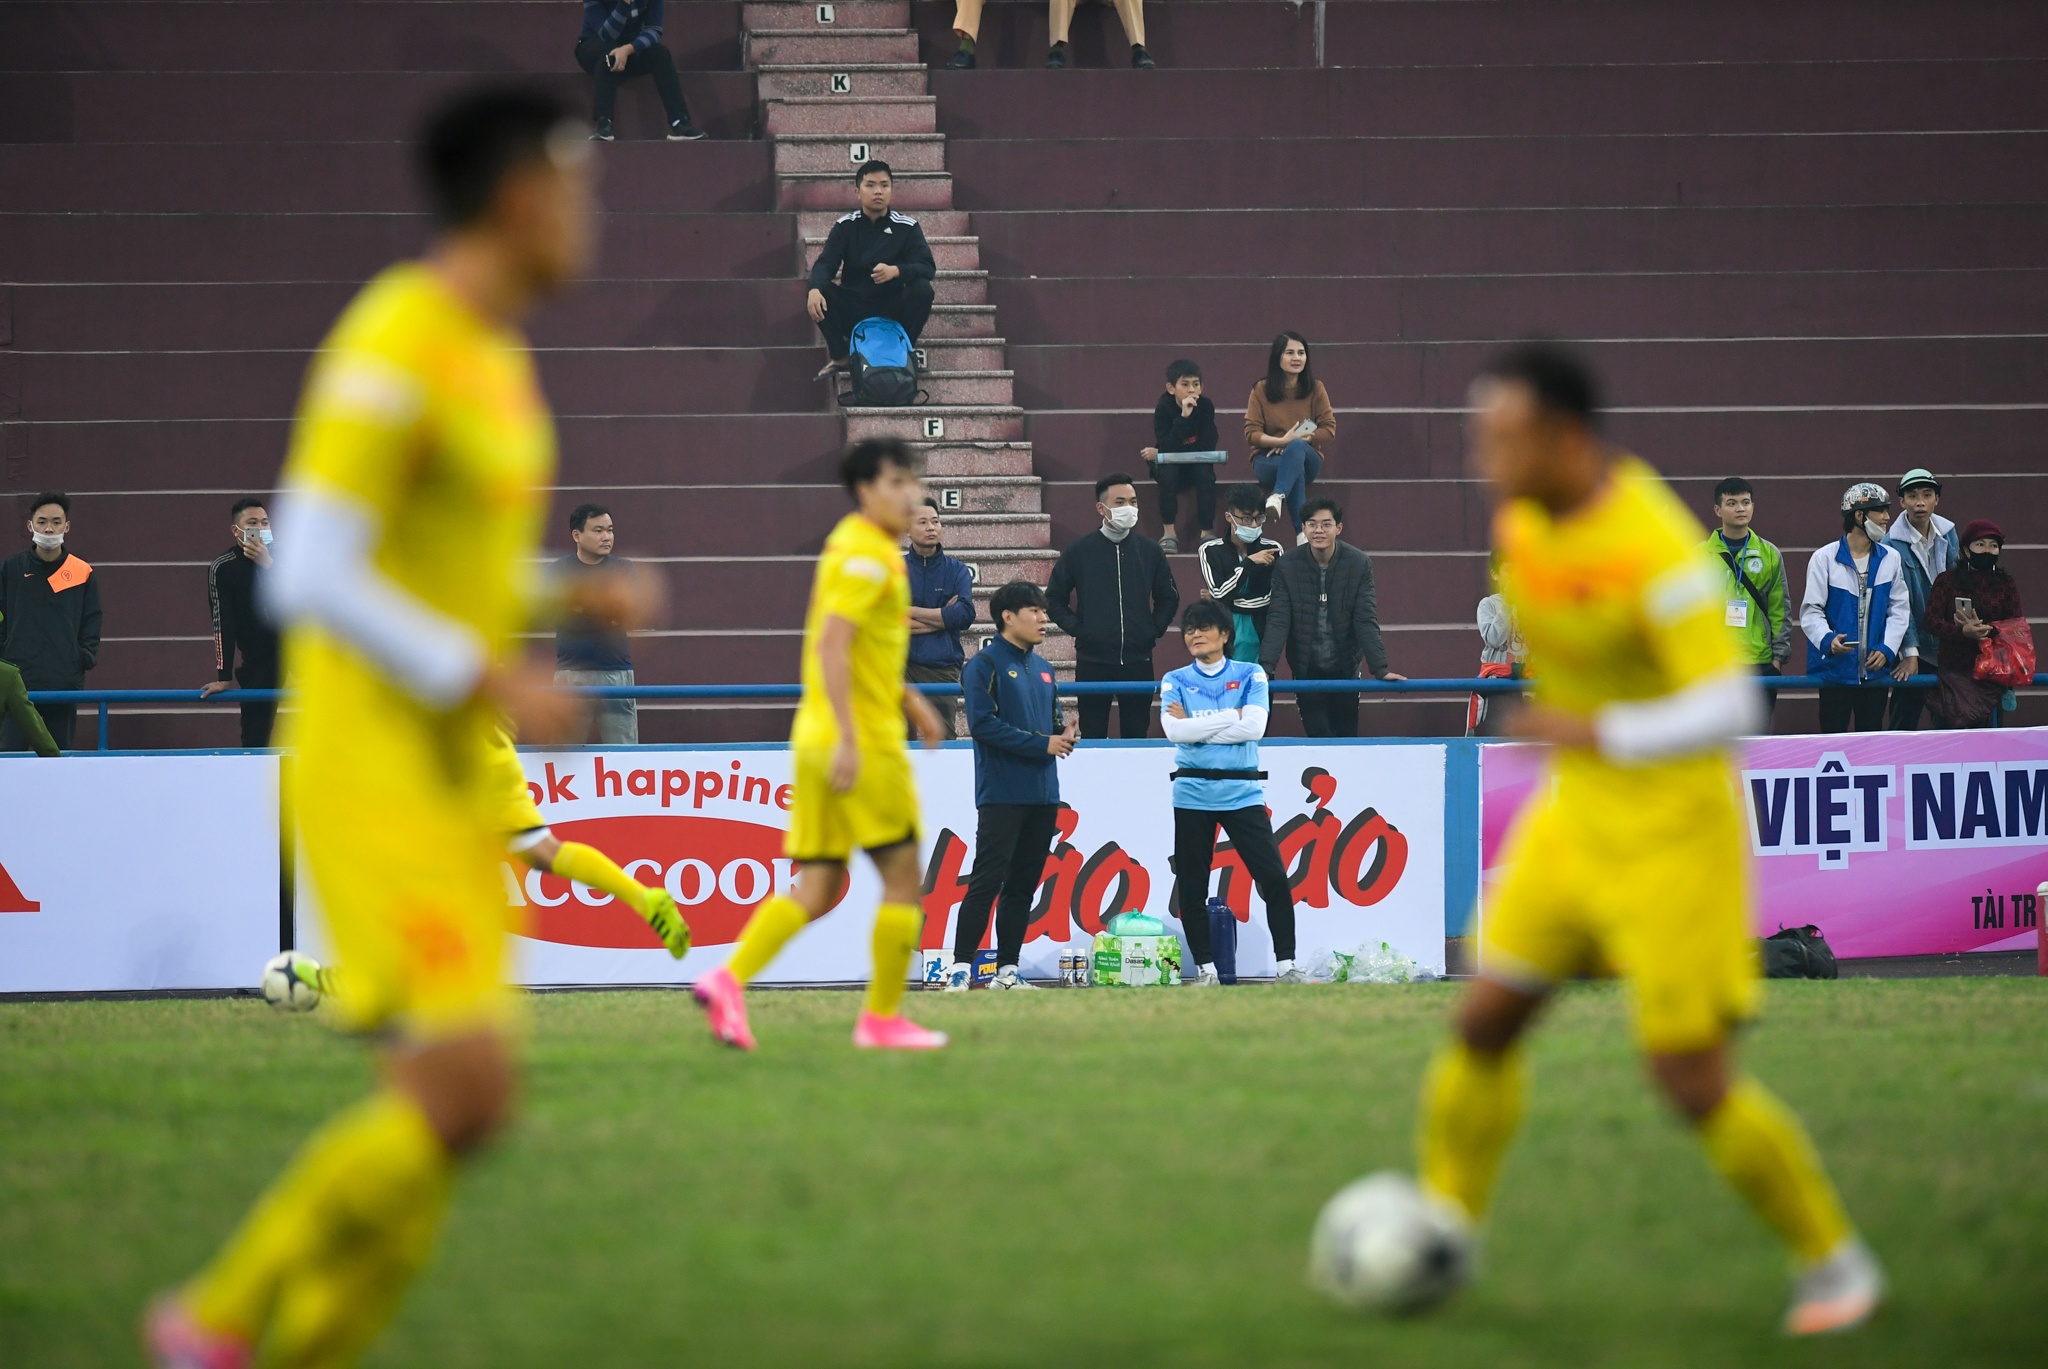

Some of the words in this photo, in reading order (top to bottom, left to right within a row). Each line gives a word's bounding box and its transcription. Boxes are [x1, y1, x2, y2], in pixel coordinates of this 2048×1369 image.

[820, 7, 831, 21] L
[834, 76, 847, 91] K
[853, 145, 865, 161] J
[928, 420, 939, 435] F
[946, 491, 958, 507] E
[1751, 760, 1889, 861] VIỆT
[1911, 769, 2048, 841] NAM
[1971, 888, 2005, 930] TÀI
